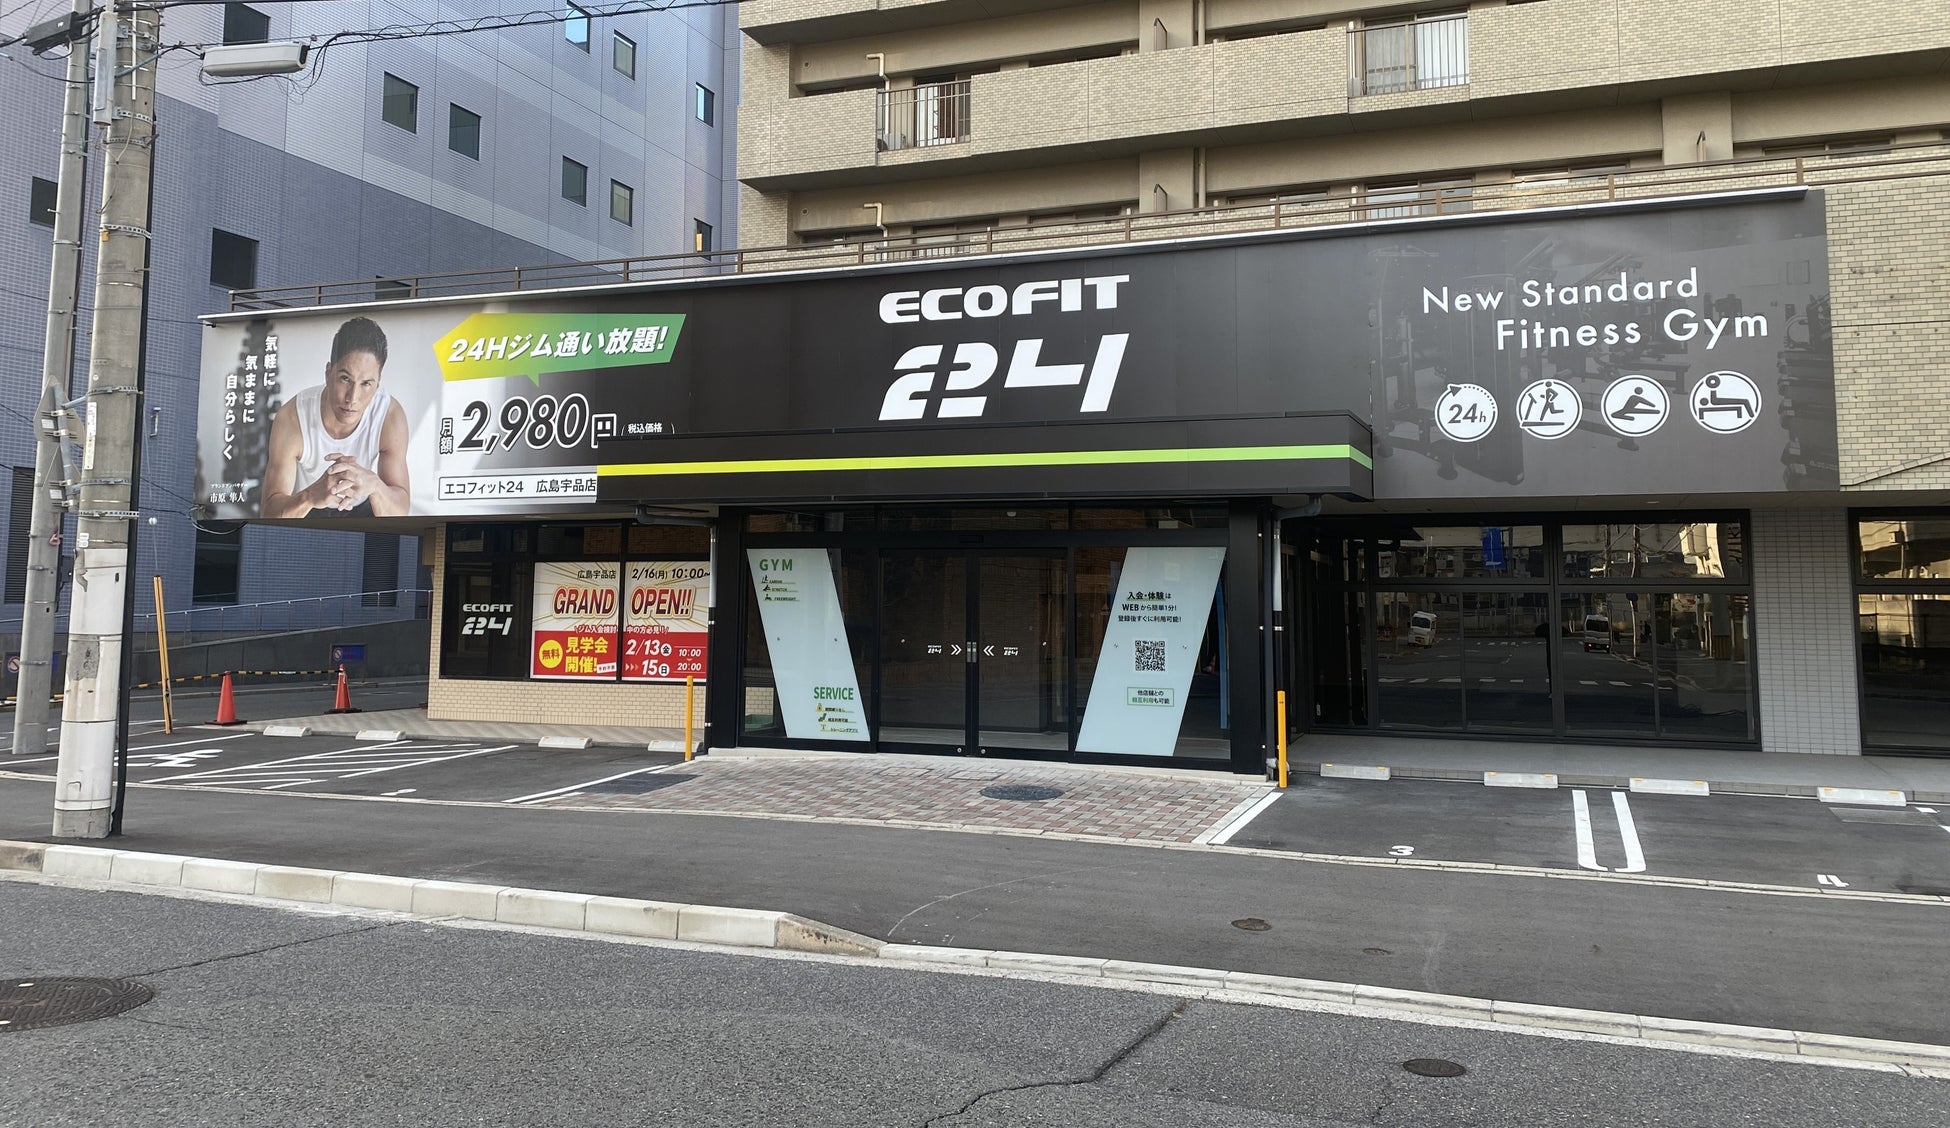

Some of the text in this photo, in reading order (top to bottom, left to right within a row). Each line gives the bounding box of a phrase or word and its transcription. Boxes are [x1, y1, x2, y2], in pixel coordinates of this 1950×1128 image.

[879, 274, 1130, 324] ECOFIT
[1423, 267, 1698, 314] New Standard
[1497, 308, 1768, 350] Fitness Gym
[263, 336, 278, 387] 気軽に
[878, 333, 1130, 421] 24
[242, 355, 258, 423] 気ままに
[223, 374, 238, 461] 自分らしく
[1448, 403, 1486, 425] 24h
[440, 418, 453, 454] 月額
[445, 478, 597, 495] エコフィット24 広島宇品店
[759, 558, 793, 571] GYM
[577, 570, 617, 579] 広島宇品店
[462, 603, 514, 613] ECOFIT
[553, 588, 615, 614] GRAND
[631, 588, 692, 615] OPEN!!
[1122, 603, 1140, 611] WEB
[461, 616, 514, 636] 24
[542, 648, 560, 660] 無料
[566, 637, 609, 653] 見学会
[679, 649, 702, 657] 10:00
[565, 656, 598, 673] 開催!
[677, 663, 702, 671] 20:00
[814, 686, 854, 700] SERVICE
[1388, 845, 1415, 856] 3
